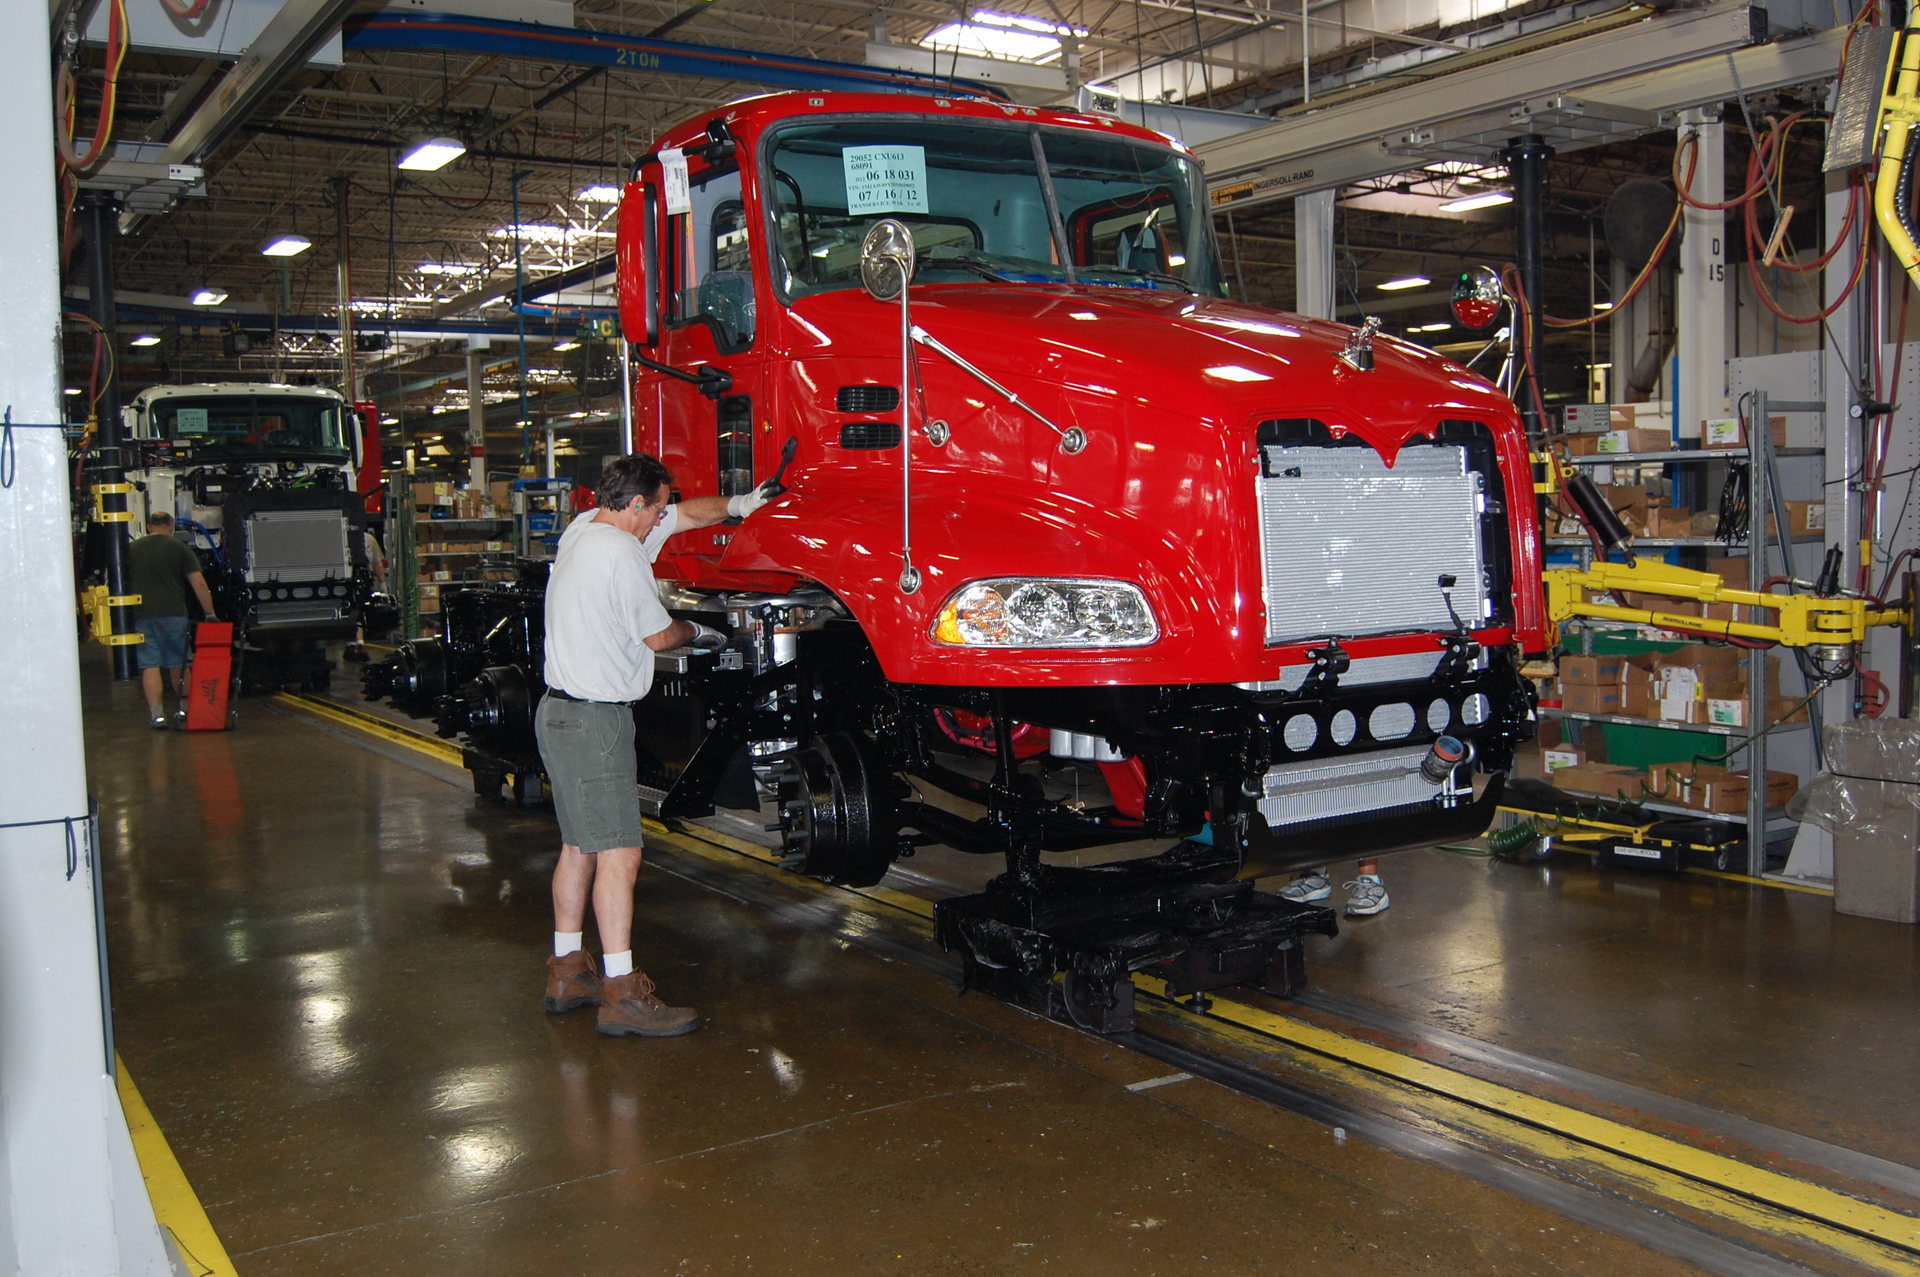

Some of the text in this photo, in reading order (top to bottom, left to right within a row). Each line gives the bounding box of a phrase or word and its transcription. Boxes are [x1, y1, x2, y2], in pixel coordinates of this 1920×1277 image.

[850, 153, 905, 162] 29052 CXU613
[851, 162, 873, 170] 68091
[866, 170, 880, 180] 06
[884, 169, 896, 180] 18
[898, 170, 915, 181] 031
[858, 191, 871, 202] 07
[884, 189, 897, 199] 16
[906, 190, 918, 200] 12
[1712, 237, 1720, 256] D
[1709, 263, 1724, 282] 15
[601, 320, 612, 336] C
